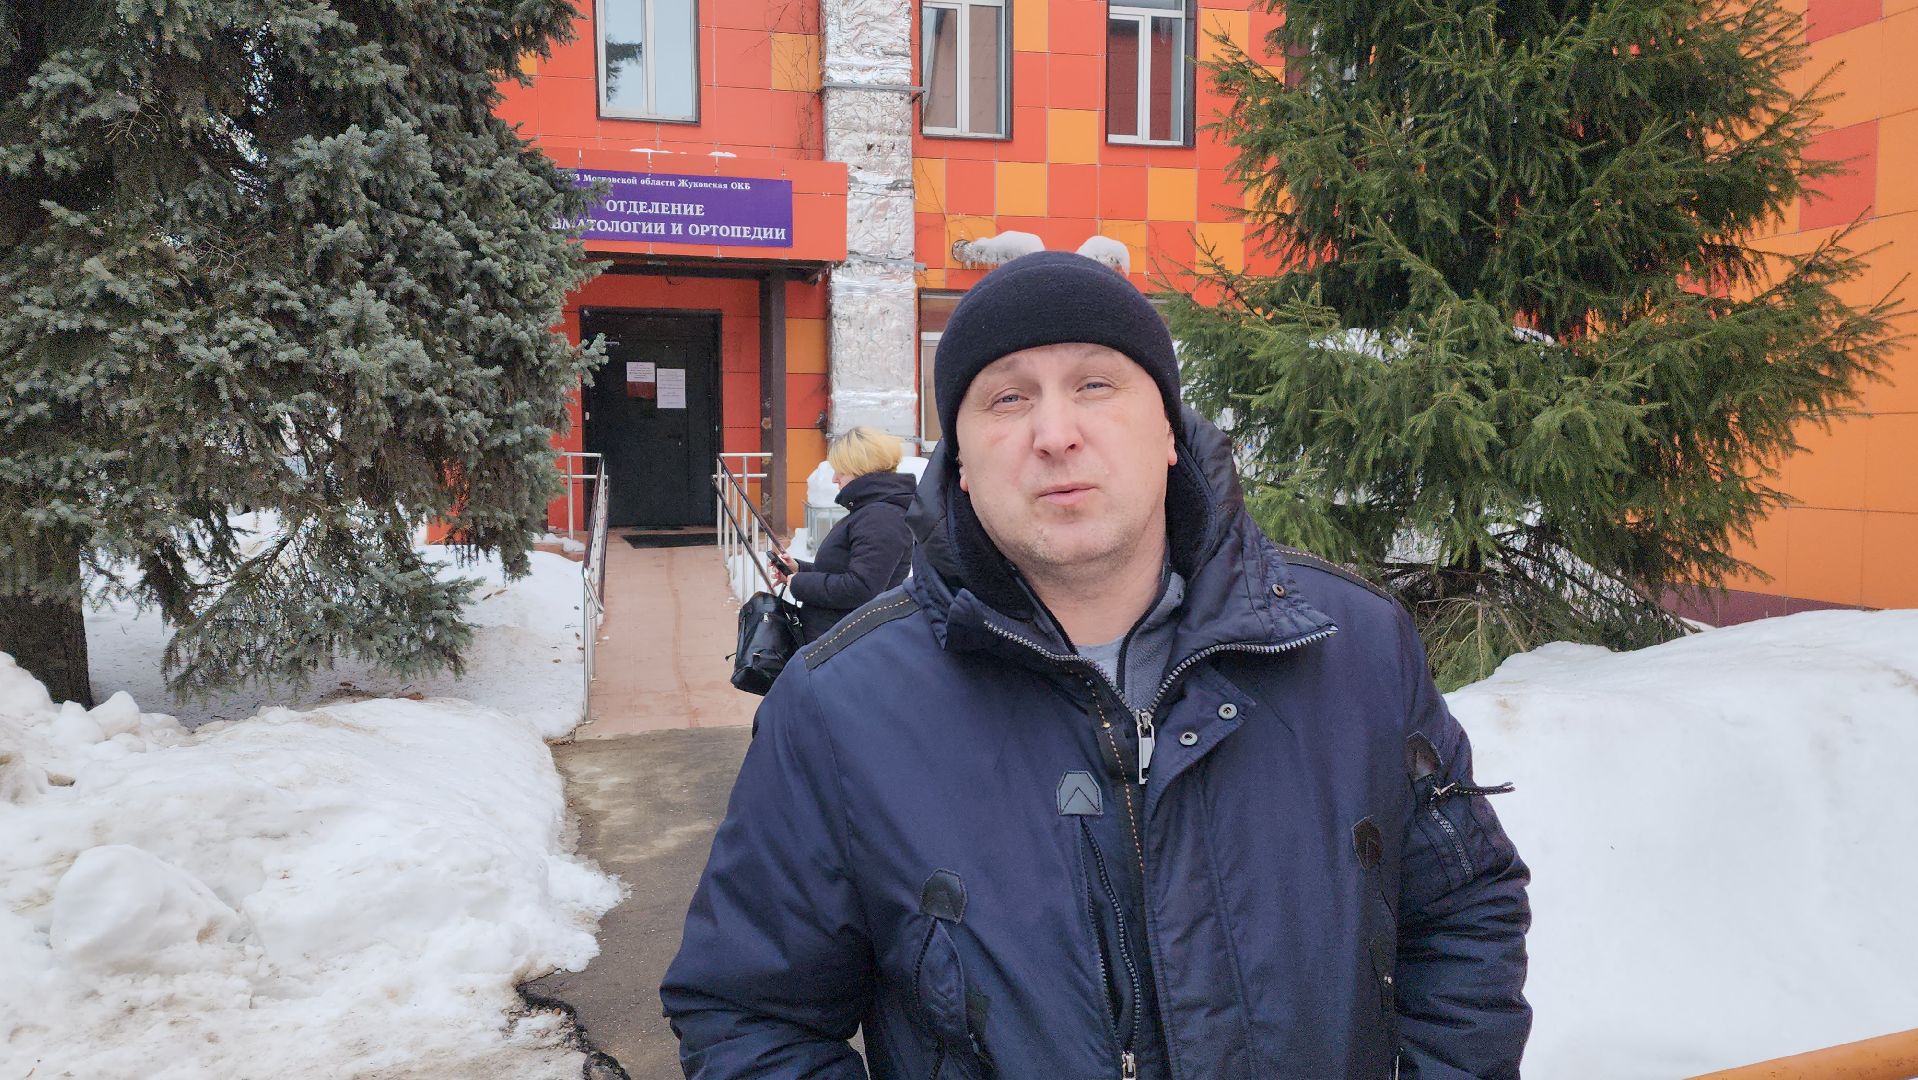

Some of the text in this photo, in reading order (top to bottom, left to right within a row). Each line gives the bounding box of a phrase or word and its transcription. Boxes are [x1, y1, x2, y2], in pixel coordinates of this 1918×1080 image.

[640, 178, 676, 187] области
[678, 178, 728, 190] Жуковская
[730, 181, 751, 190] ОКБ
[606, 200, 705, 216] ОТДЕЛЕНИЕ
[549, 217, 786, 240] ВМАТОЛОГИИ И ОРТОПЕДИИ
